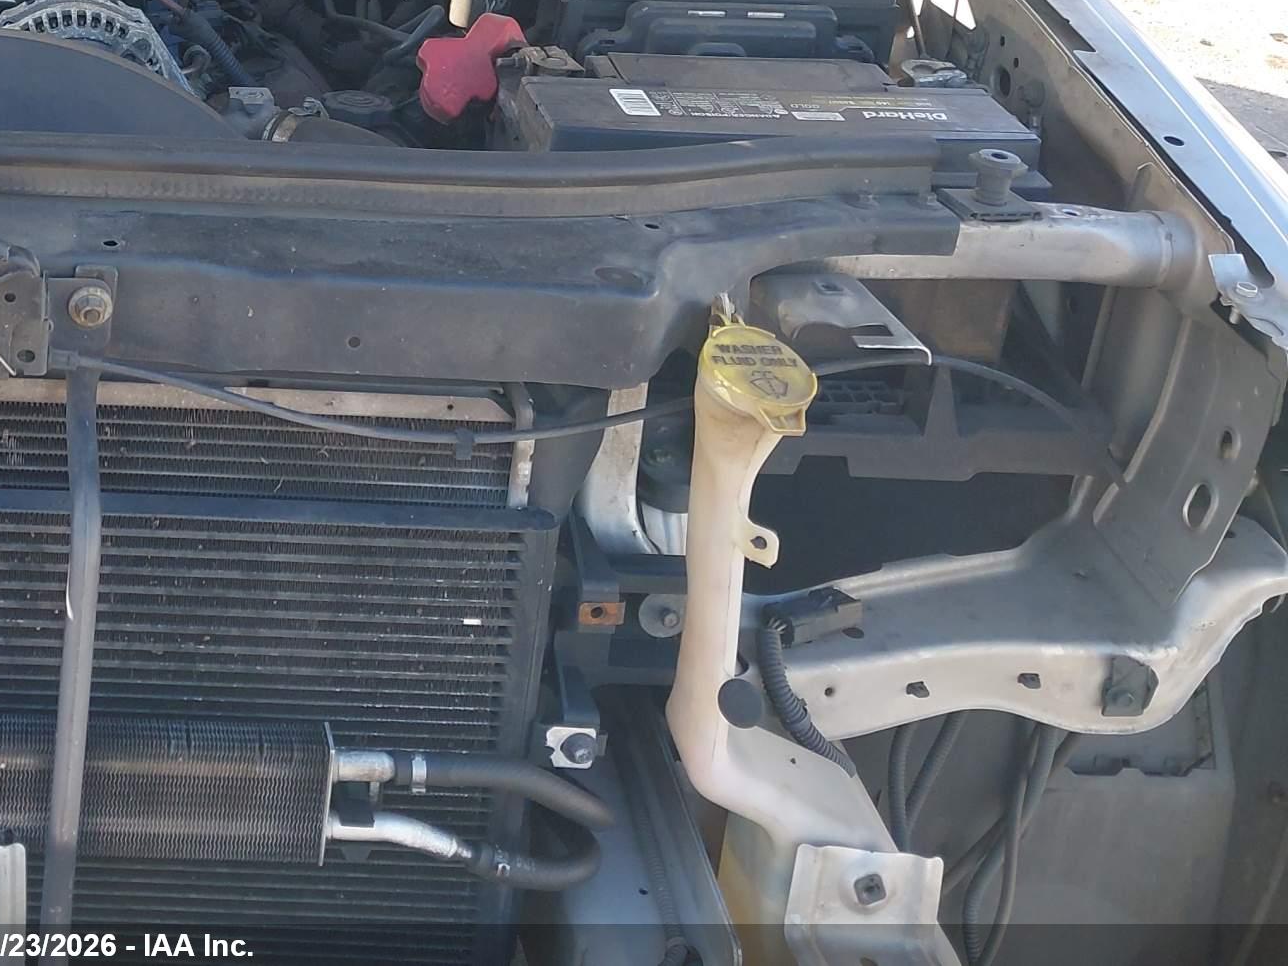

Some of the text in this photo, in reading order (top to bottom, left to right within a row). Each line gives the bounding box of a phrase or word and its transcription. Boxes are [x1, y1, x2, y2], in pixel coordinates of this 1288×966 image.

[862, 110, 949, 121] DieHard
[715, 344, 783, 354] WASHER
[712, 355, 798, 367] FLUID ONLY
